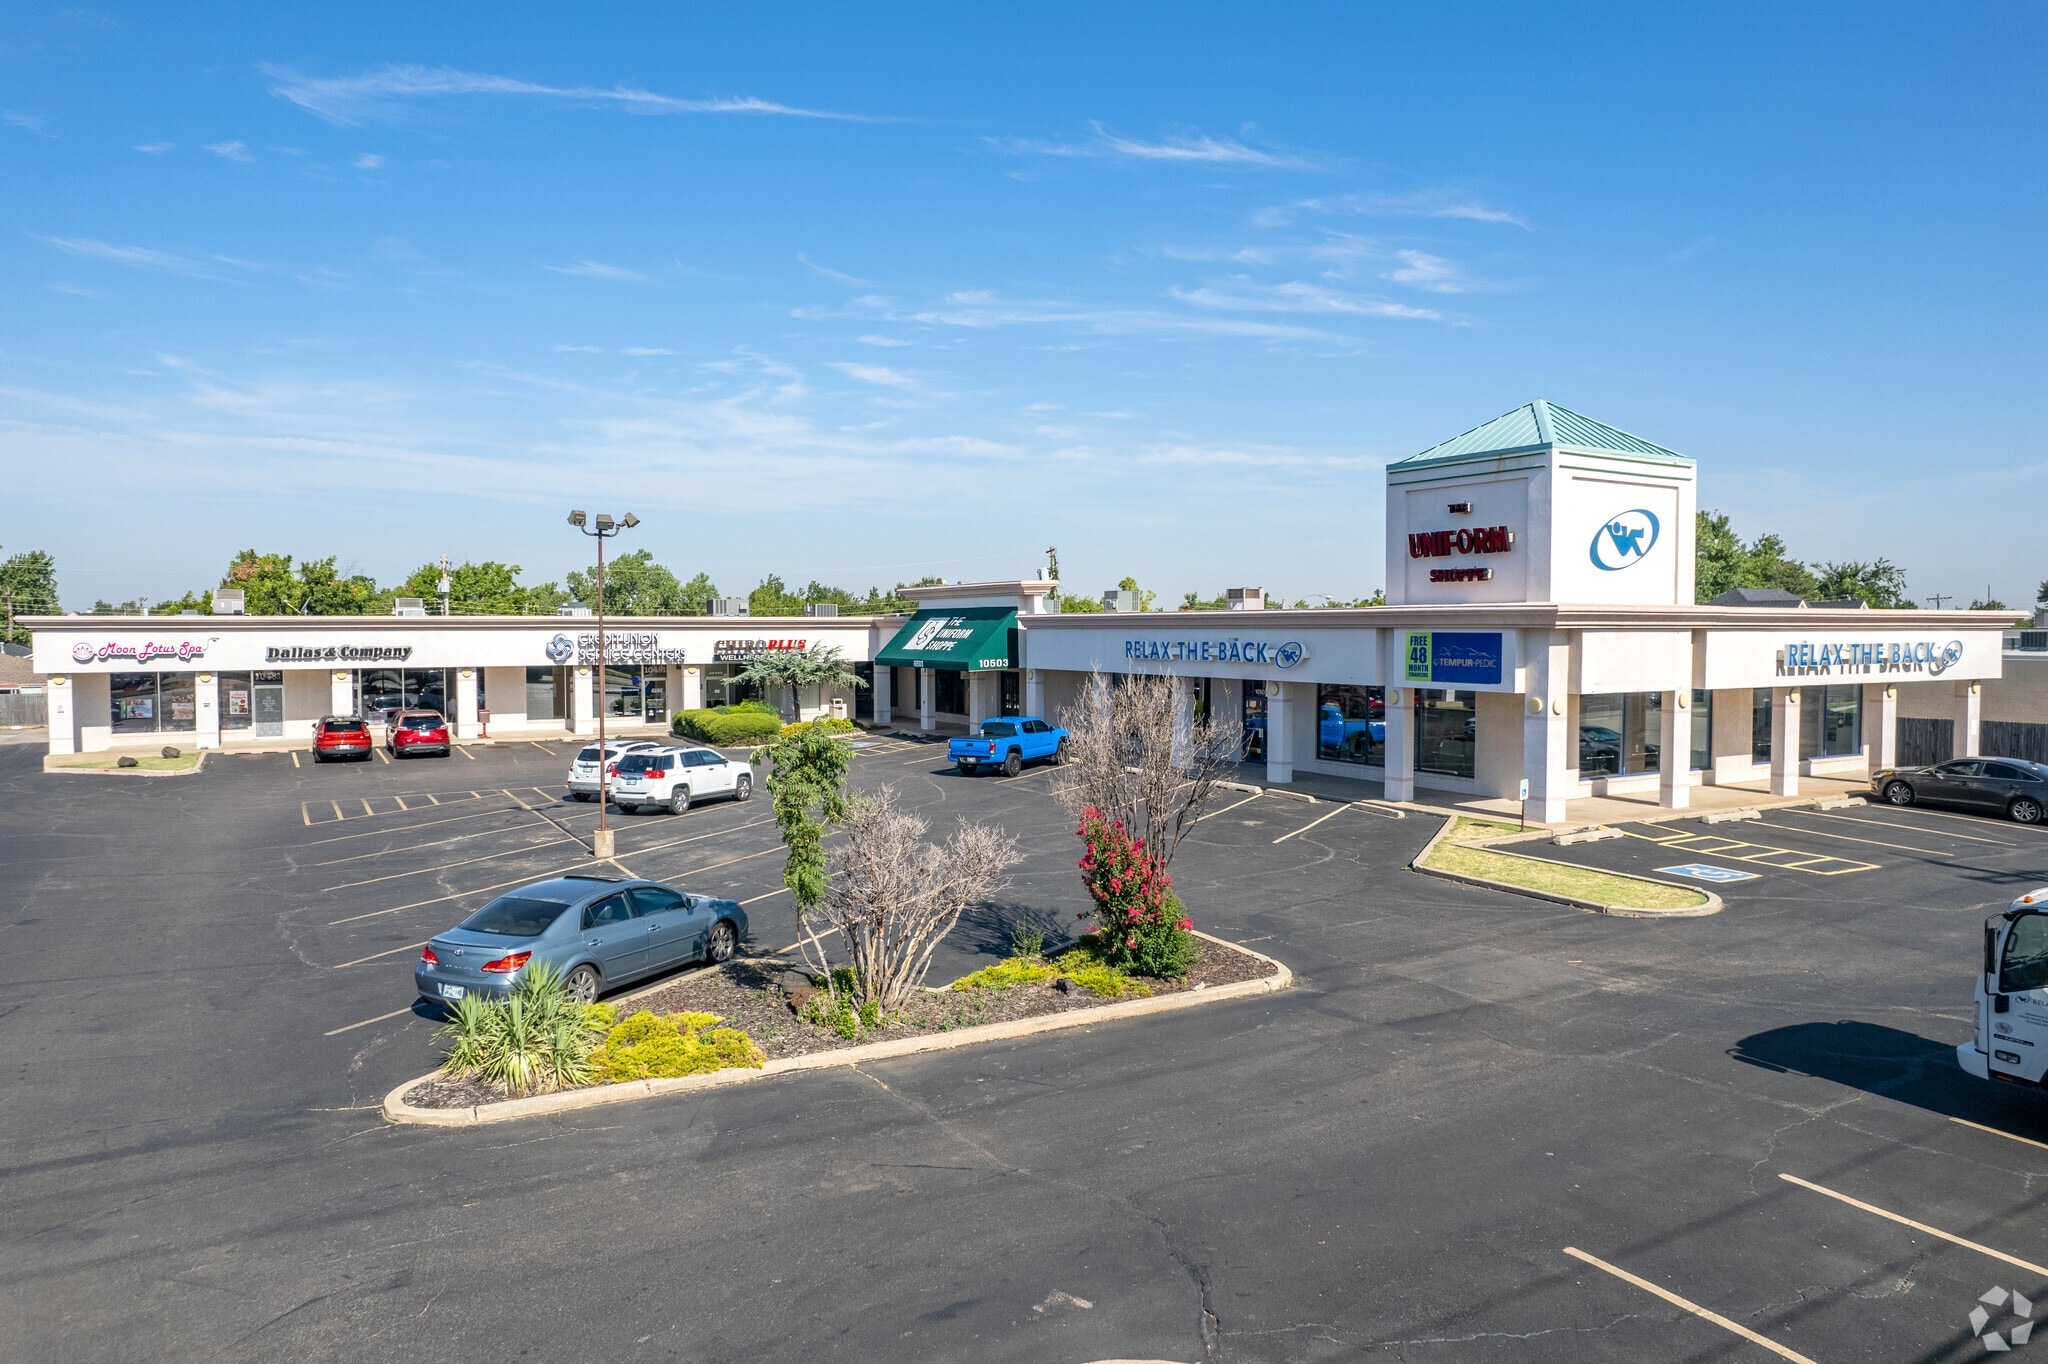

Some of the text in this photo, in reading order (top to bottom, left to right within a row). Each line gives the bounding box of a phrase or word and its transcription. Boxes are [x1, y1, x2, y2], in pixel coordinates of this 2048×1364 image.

[1408, 525, 1511, 558] UNIFORM
[1429, 568, 1488, 582] SHOPPE
[947, 616, 967, 626] THE
[578, 633, 660, 645] CREDIT UNION
[936, 628, 974, 639] UNIFORM
[925, 640, 958, 651] SHOPPE
[1409, 635, 1428, 647] FREE
[98, 641, 203, 659] Moon Lotus Spa
[266, 645, 412, 661] Dallas & Company
[579, 648, 687, 660] SERVICE CENTERS
[1125, 640, 1268, 663] RELAX THE BACK
[1409, 646, 1428, 664] 48
[1787, 642, 1936, 667] RELAX THE BACK
[978, 658, 1009, 668] 10503
[1408, 664, 1429, 672] MONTH
